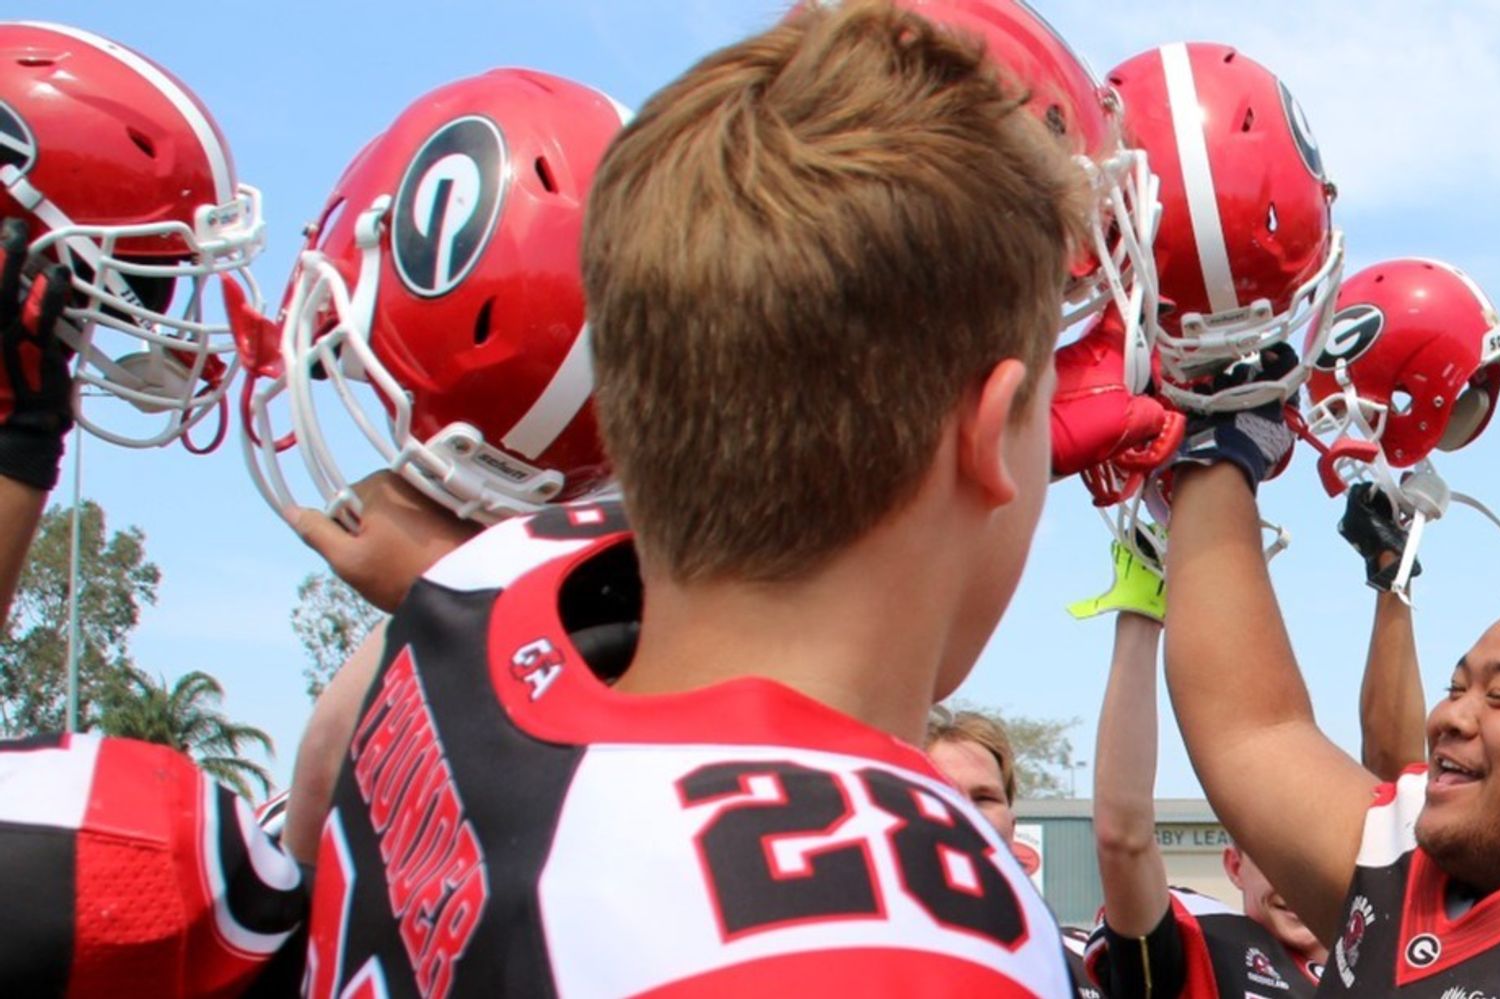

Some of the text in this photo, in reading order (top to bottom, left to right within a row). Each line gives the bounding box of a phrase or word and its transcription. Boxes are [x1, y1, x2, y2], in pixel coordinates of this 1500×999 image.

[351, 642, 490, 998] THUNDER
[673, 760, 1030, 953] 28
[1405, 933, 1441, 968] G
